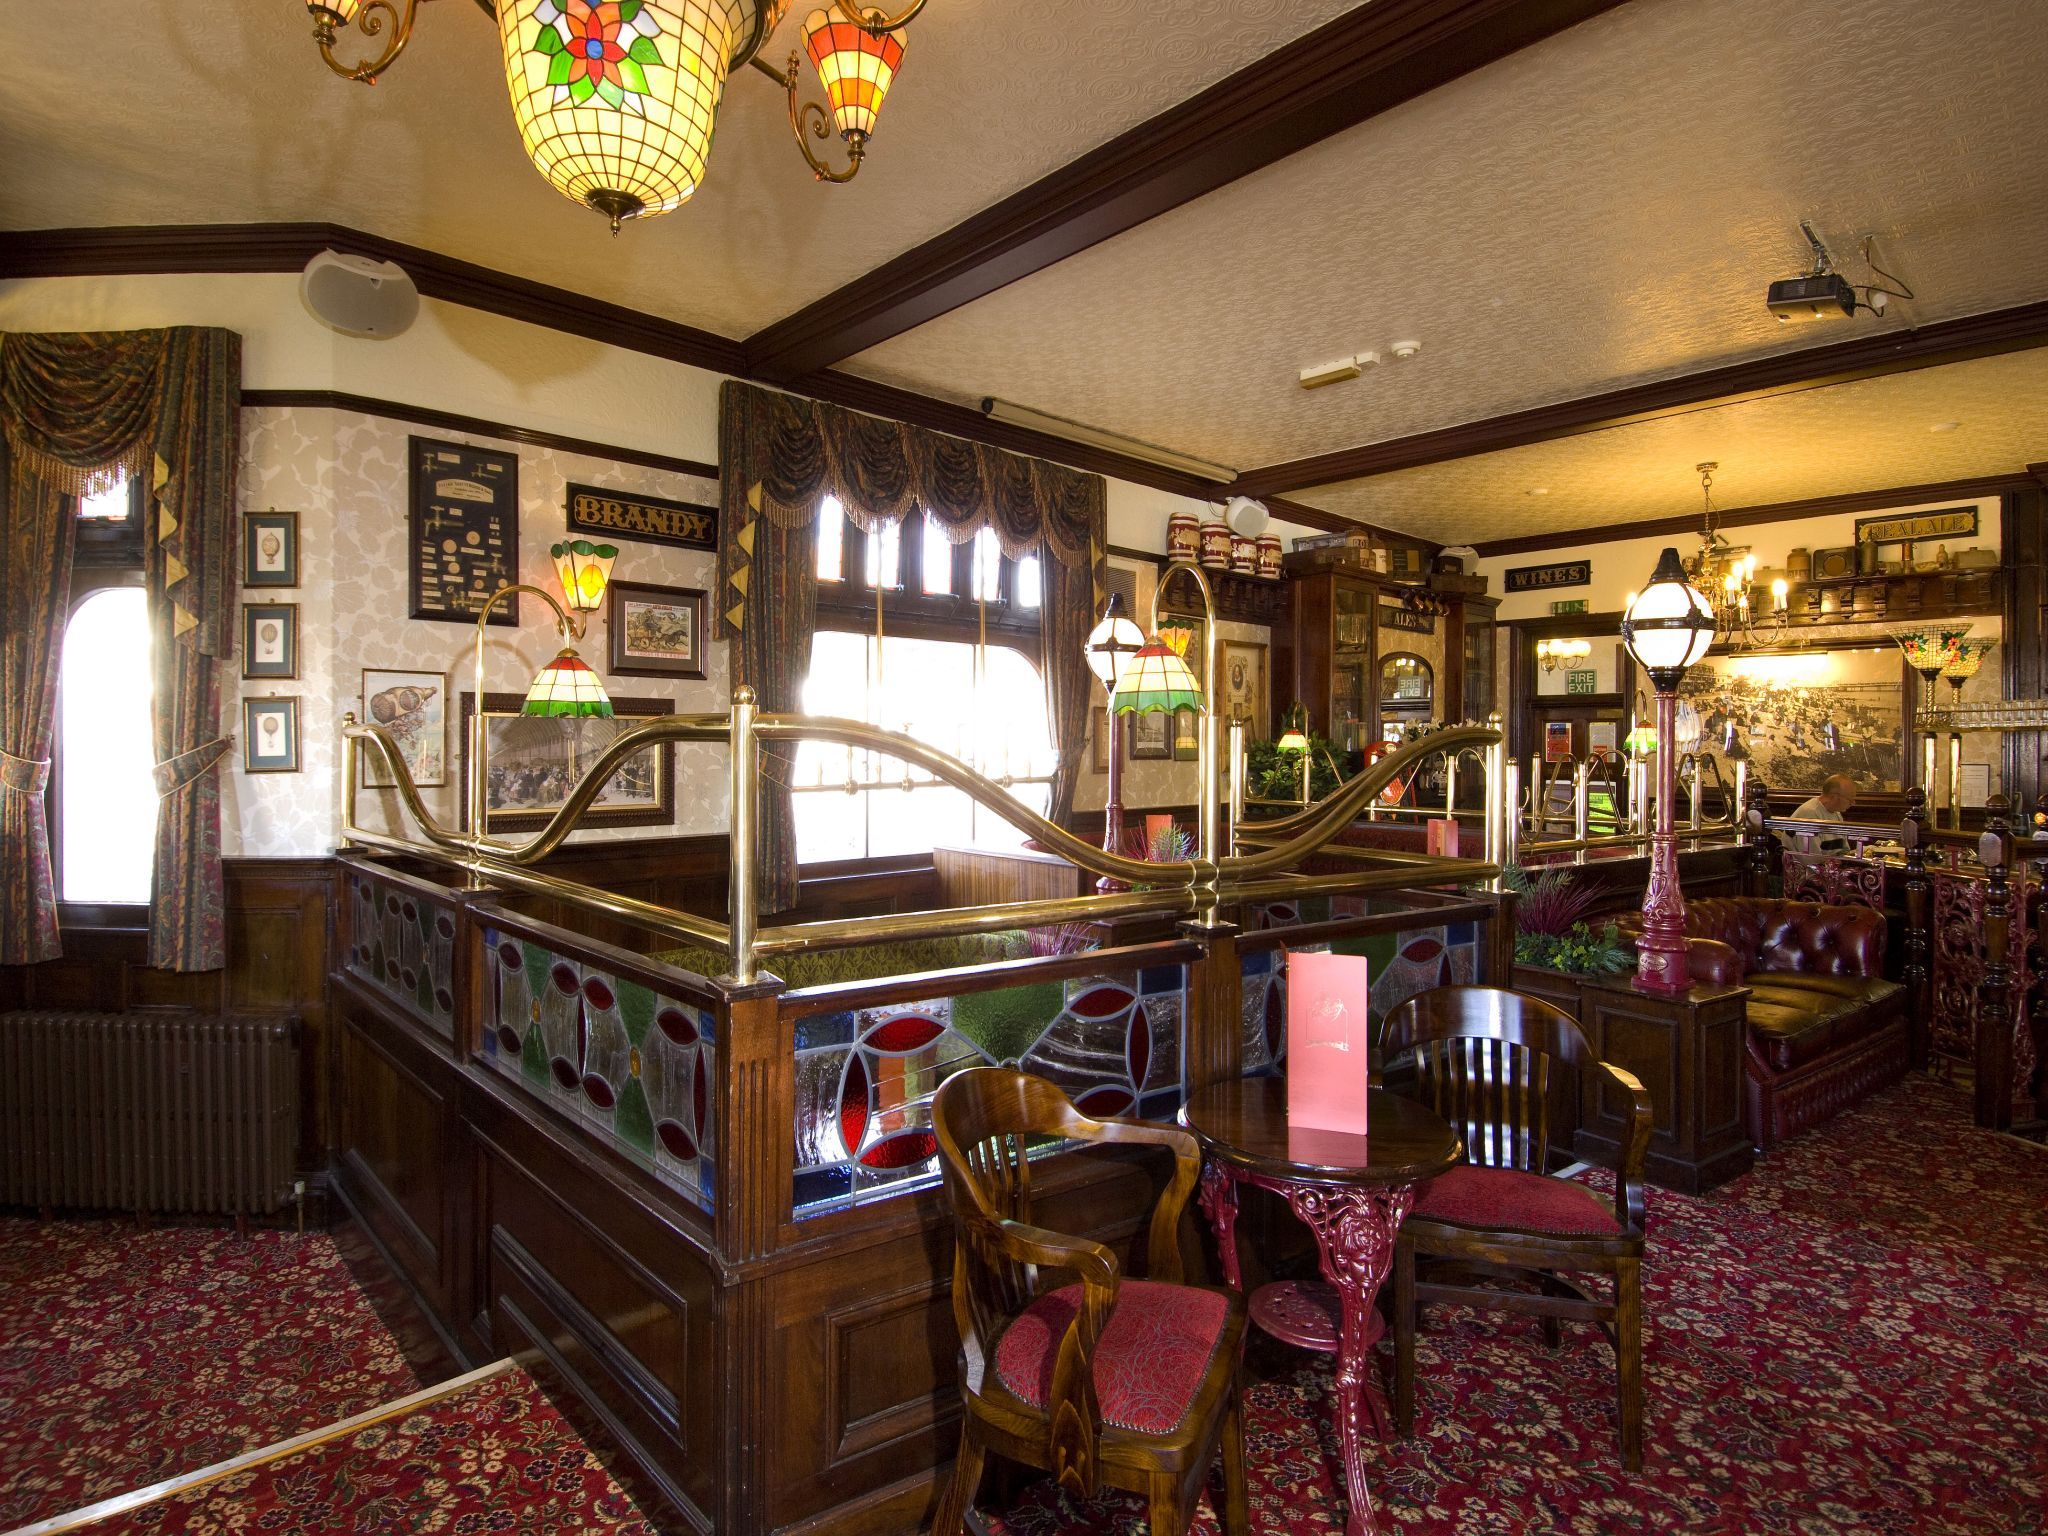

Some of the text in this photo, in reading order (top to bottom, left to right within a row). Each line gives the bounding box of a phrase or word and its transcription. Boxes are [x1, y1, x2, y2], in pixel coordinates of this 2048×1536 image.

[577, 496, 711, 540] BRANDY
[1927, 516, 1965, 534] ALE
[1515, 566, 1580, 586] WINES
[1568, 672, 1594, 683] FIRE
[1568, 683, 1594, 693] EXIT
